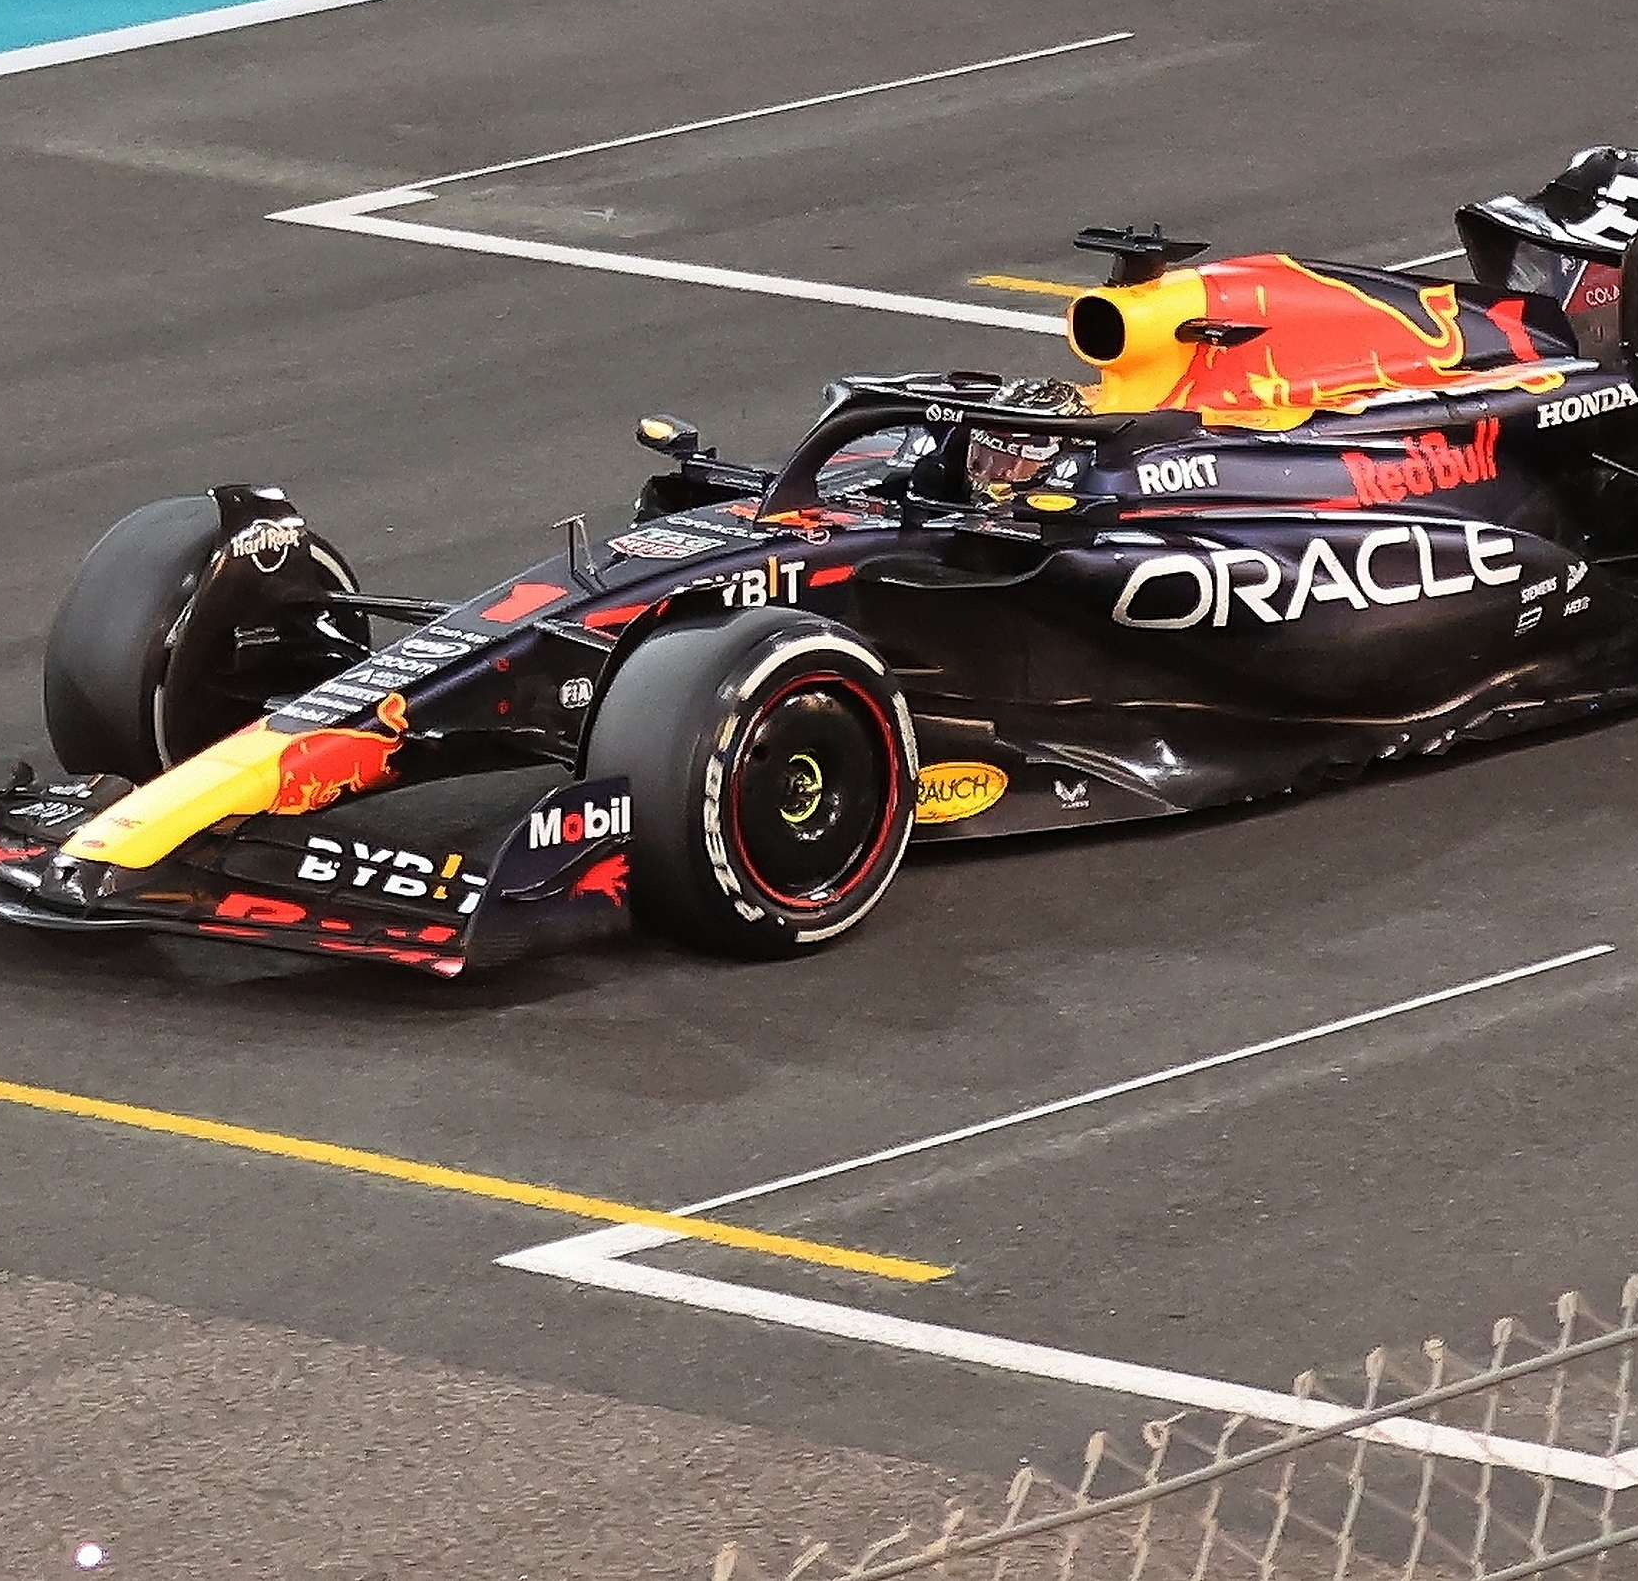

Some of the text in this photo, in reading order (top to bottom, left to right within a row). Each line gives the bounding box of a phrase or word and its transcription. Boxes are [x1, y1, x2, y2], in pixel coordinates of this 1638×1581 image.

[1137, 454, 1219, 496] ROKT
[692, 556, 806, 607] YBIT
[1111, 522, 1523, 631] ORACLE
[528, 795, 632, 850] Mobil
